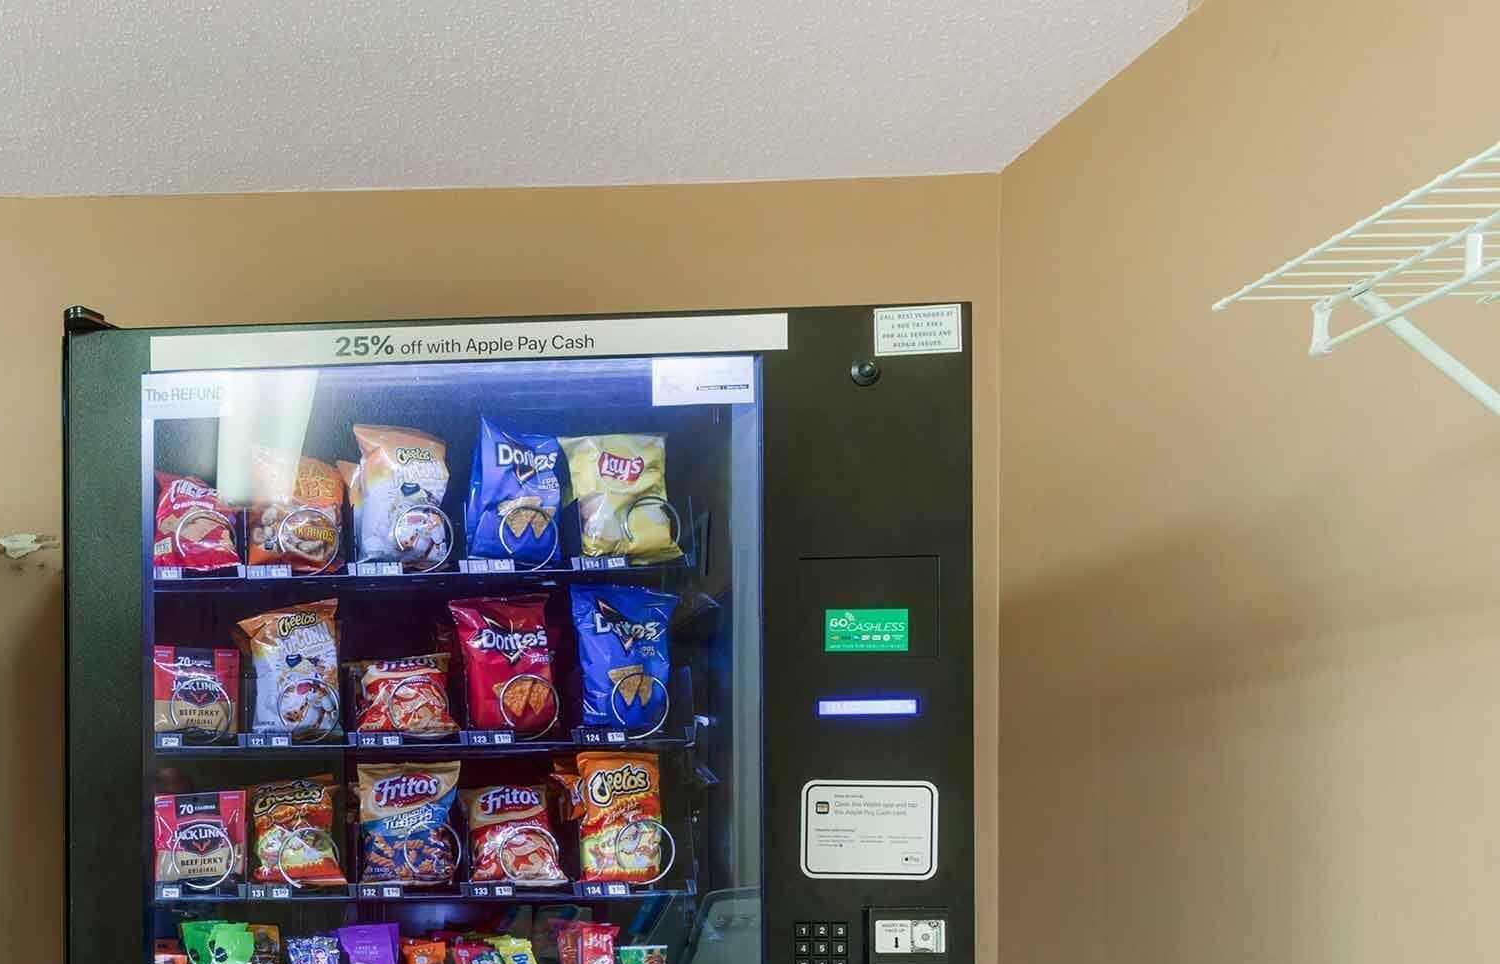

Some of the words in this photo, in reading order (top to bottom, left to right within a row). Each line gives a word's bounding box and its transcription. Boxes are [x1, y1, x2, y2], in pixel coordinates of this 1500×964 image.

[335, 336, 394, 356] 25%
[400, 339, 423, 354] off
[426, 338, 461, 353] with
[466, 335, 514, 355] Apple
[517, 334, 548, 353] Pay
[551, 332, 595, 350] Cash
[497, 443, 558, 471] Doritos
[600, 451, 643, 481] Lay's
[277, 611, 318, 637] Cheetos
[829, 618, 847, 630] GO
[847, 621, 906, 632] CASHLESS
[479, 626, 548, 652] Doritos
[251, 737, 264, 745] 121
[361, 737, 375, 745] 122
[472, 735, 487, 744] 123
[586, 734, 600, 743] 124
[372, 774, 439, 807] Fritos
[478, 786, 541, 815] Fritos
[179, 803, 194, 815] 70
[251, 890, 265, 898] 131
[362, 888, 376, 897] 132
[474, 887, 488, 895] 133
[586, 886, 601, 894] 134
